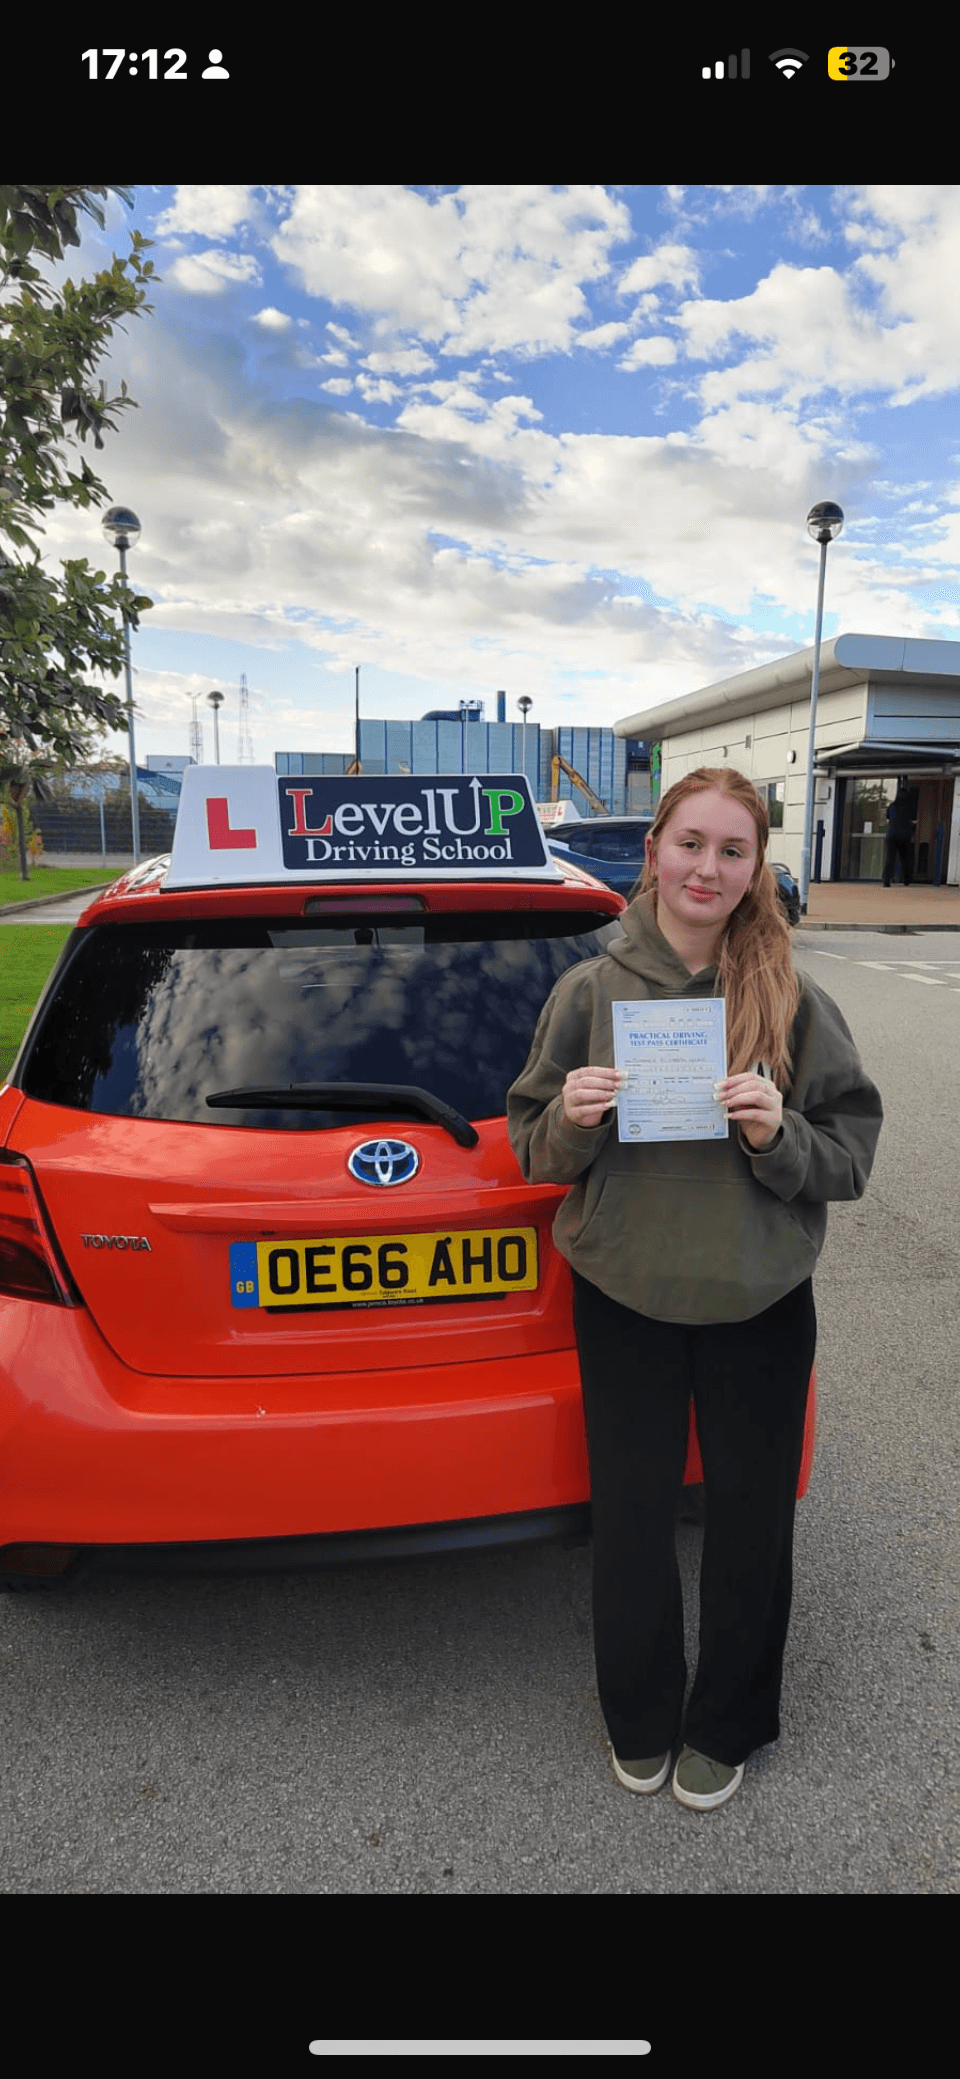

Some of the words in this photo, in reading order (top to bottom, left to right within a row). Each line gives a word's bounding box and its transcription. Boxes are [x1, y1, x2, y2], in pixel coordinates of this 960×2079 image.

[205, 796, 257, 850] L
[285, 787, 526, 837] LevelUP
[305, 837, 415, 866] Driving
[423, 836, 514, 862] School
[630, 1039, 645, 1047] TEST
[79, 1233, 153, 1252] TOYOTA
[268, 1241, 409, 1296] OE66
[428, 1235, 528, 1288] AHO
[235, 1279, 255, 1294] GB
